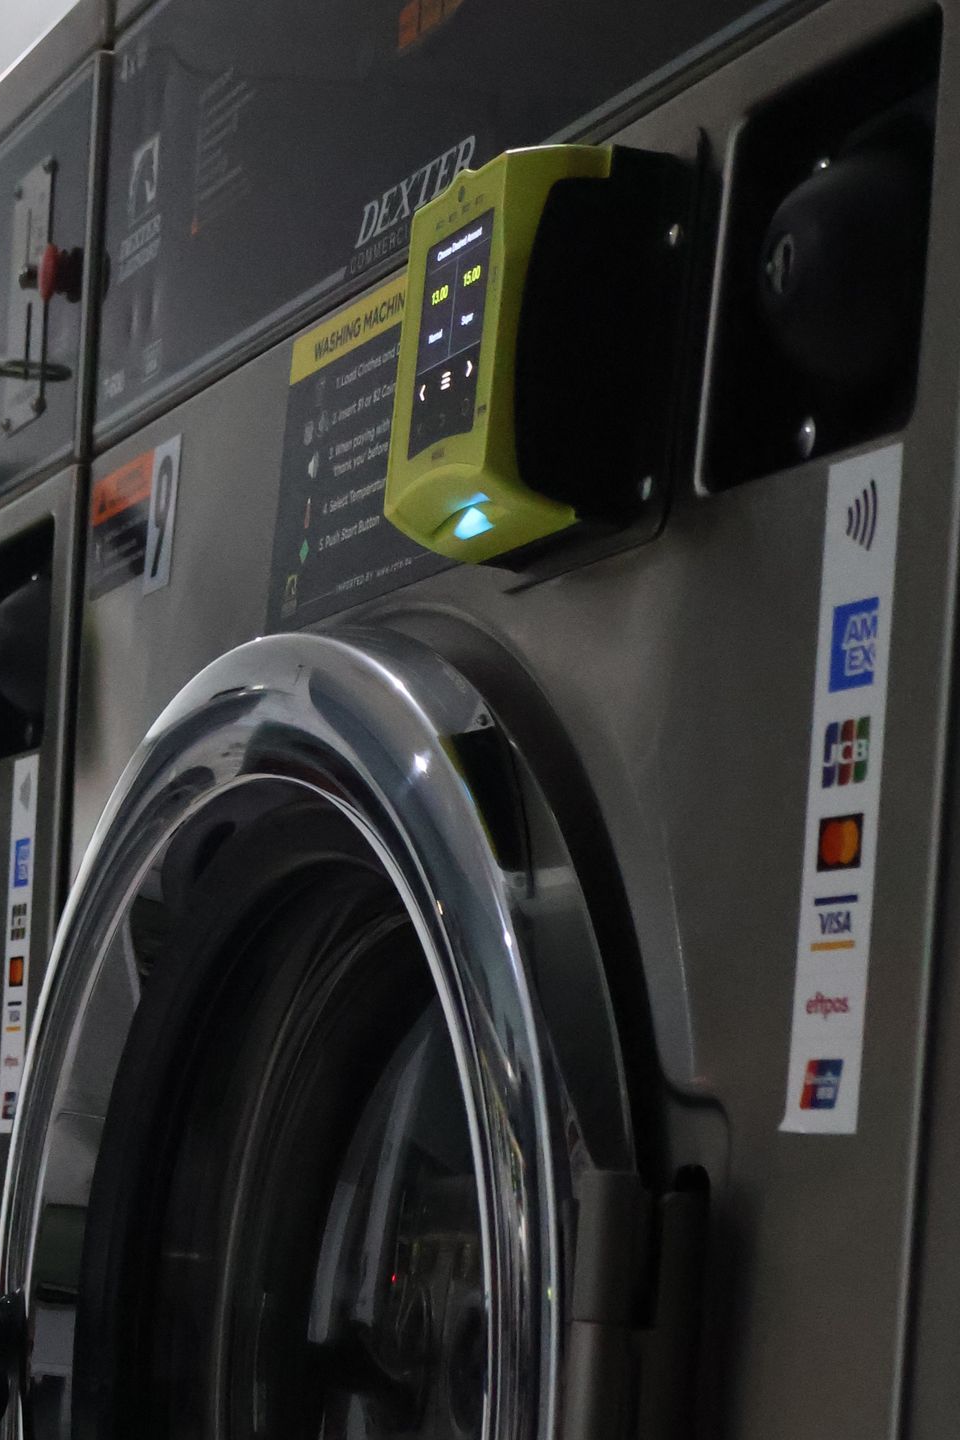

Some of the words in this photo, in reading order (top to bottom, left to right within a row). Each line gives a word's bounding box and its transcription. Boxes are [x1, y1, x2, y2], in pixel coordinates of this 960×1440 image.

[355, 135, 476, 249] DEXTER
[463, 265, 481, 287] 15.00
[431, 285, 449, 305] 13.00
[314, 317, 361, 362] WASHING
[155, 455, 173, 578] 9
[325, 530, 341, 548] Push
[341, 525, 358, 542] Start
[358, 515, 380, 535] Button
[844, 611, 878, 645] AM
[845, 643, 876, 674] EX
[823, 739, 868, 767] JCB
[819, 911, 851, 934] VISA
[806, 992, 849, 1019] eftpos
